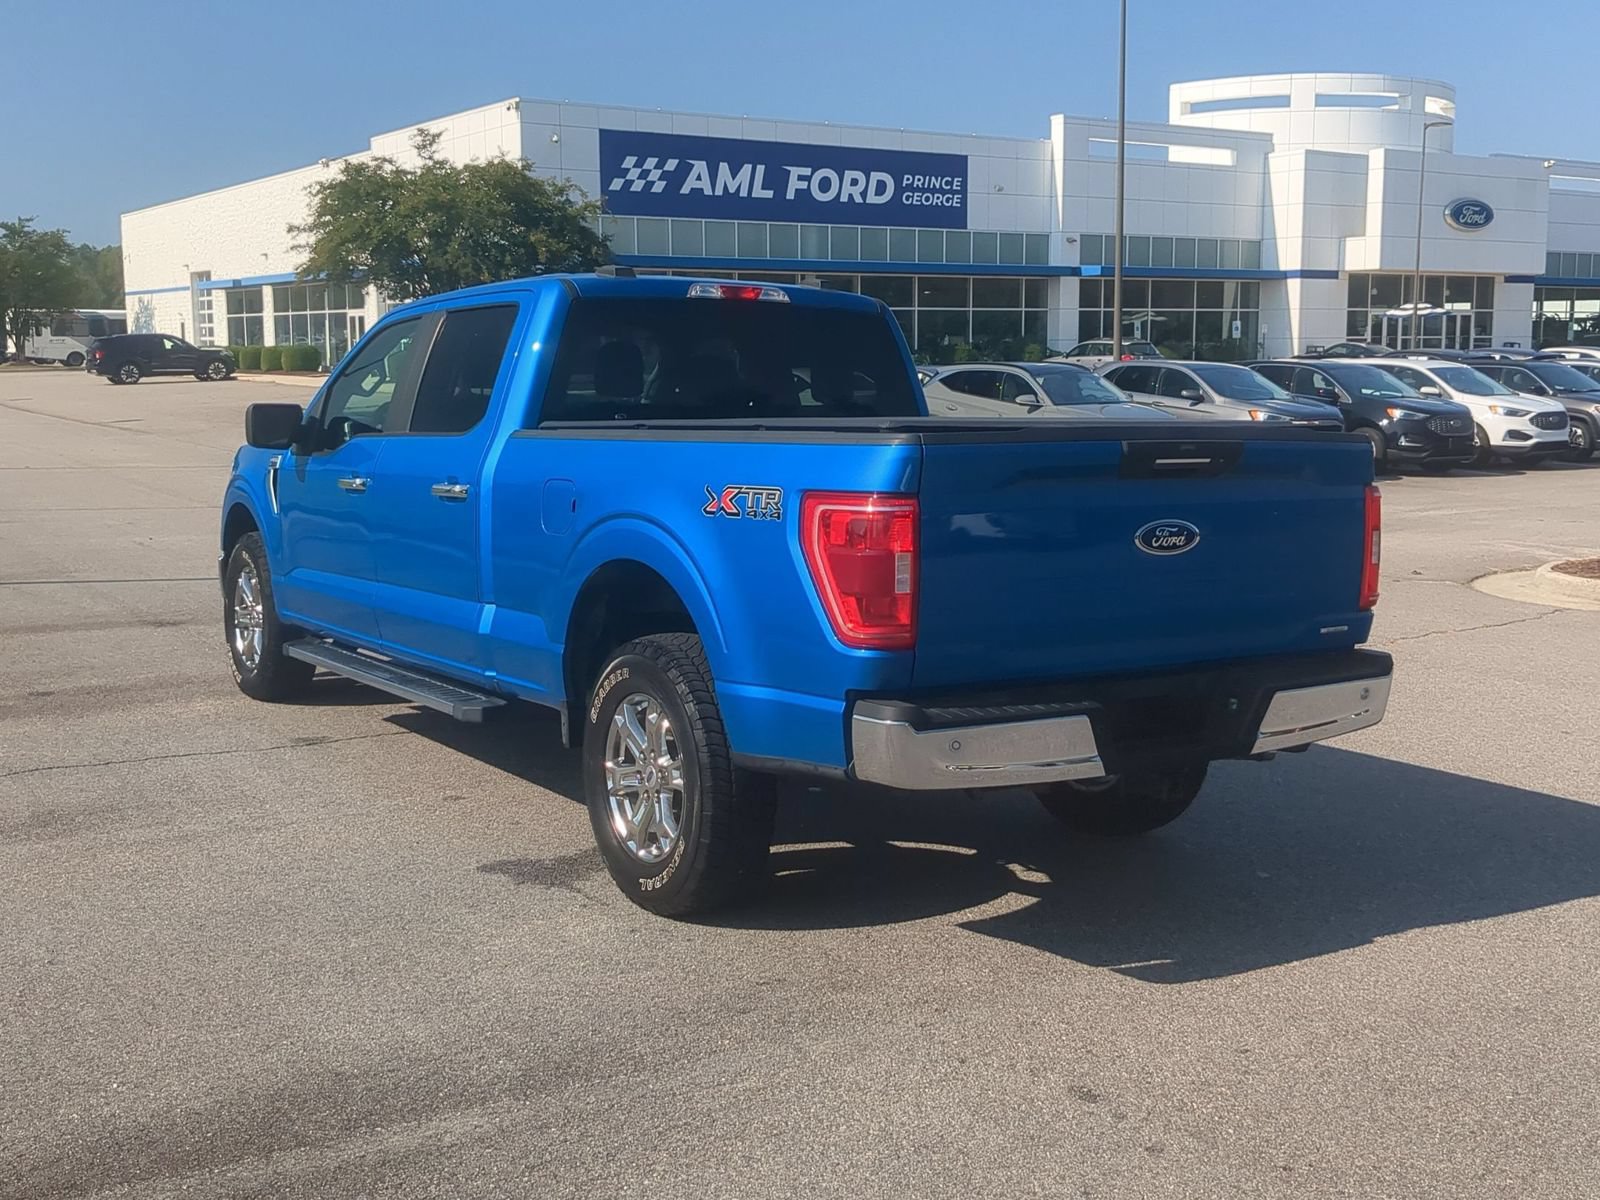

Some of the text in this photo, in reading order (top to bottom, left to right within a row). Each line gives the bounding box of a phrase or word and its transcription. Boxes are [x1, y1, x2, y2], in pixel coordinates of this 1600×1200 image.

[680, 159, 895, 204] AML FORD
[902, 174, 962, 190] PRINCE
[902, 191, 962, 207] GEORGE
[1459, 205, 1487, 224] Ford
[701, 484, 783, 518] XTR
[1152, 526, 1188, 547] Ford
